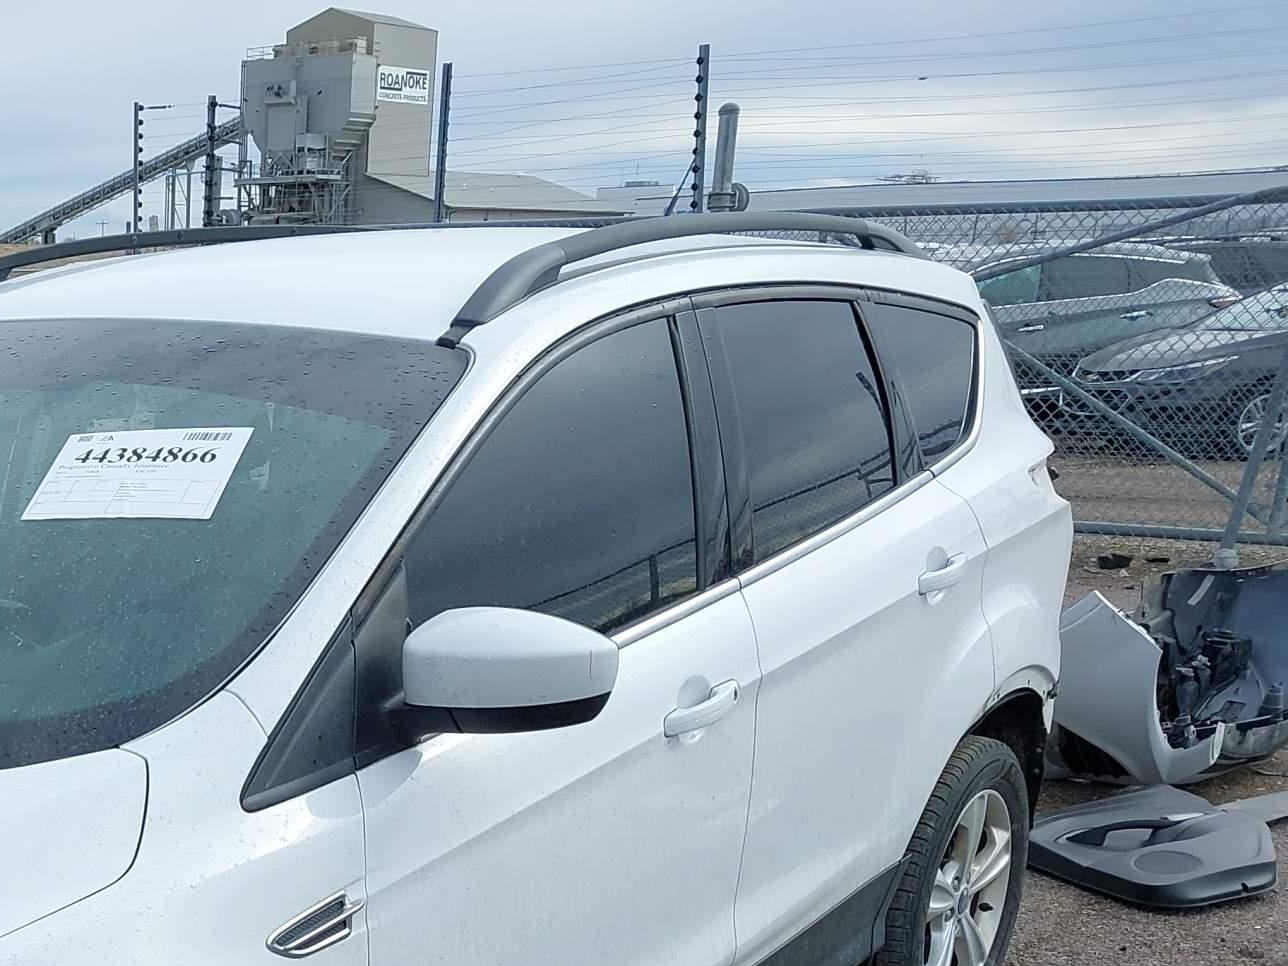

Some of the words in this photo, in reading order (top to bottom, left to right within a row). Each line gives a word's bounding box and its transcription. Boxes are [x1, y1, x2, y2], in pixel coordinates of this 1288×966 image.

[380, 71, 427, 90] ROANOKE
[379, 92, 402, 100] CONCRETE
[75, 446, 220, 463] 44384866
